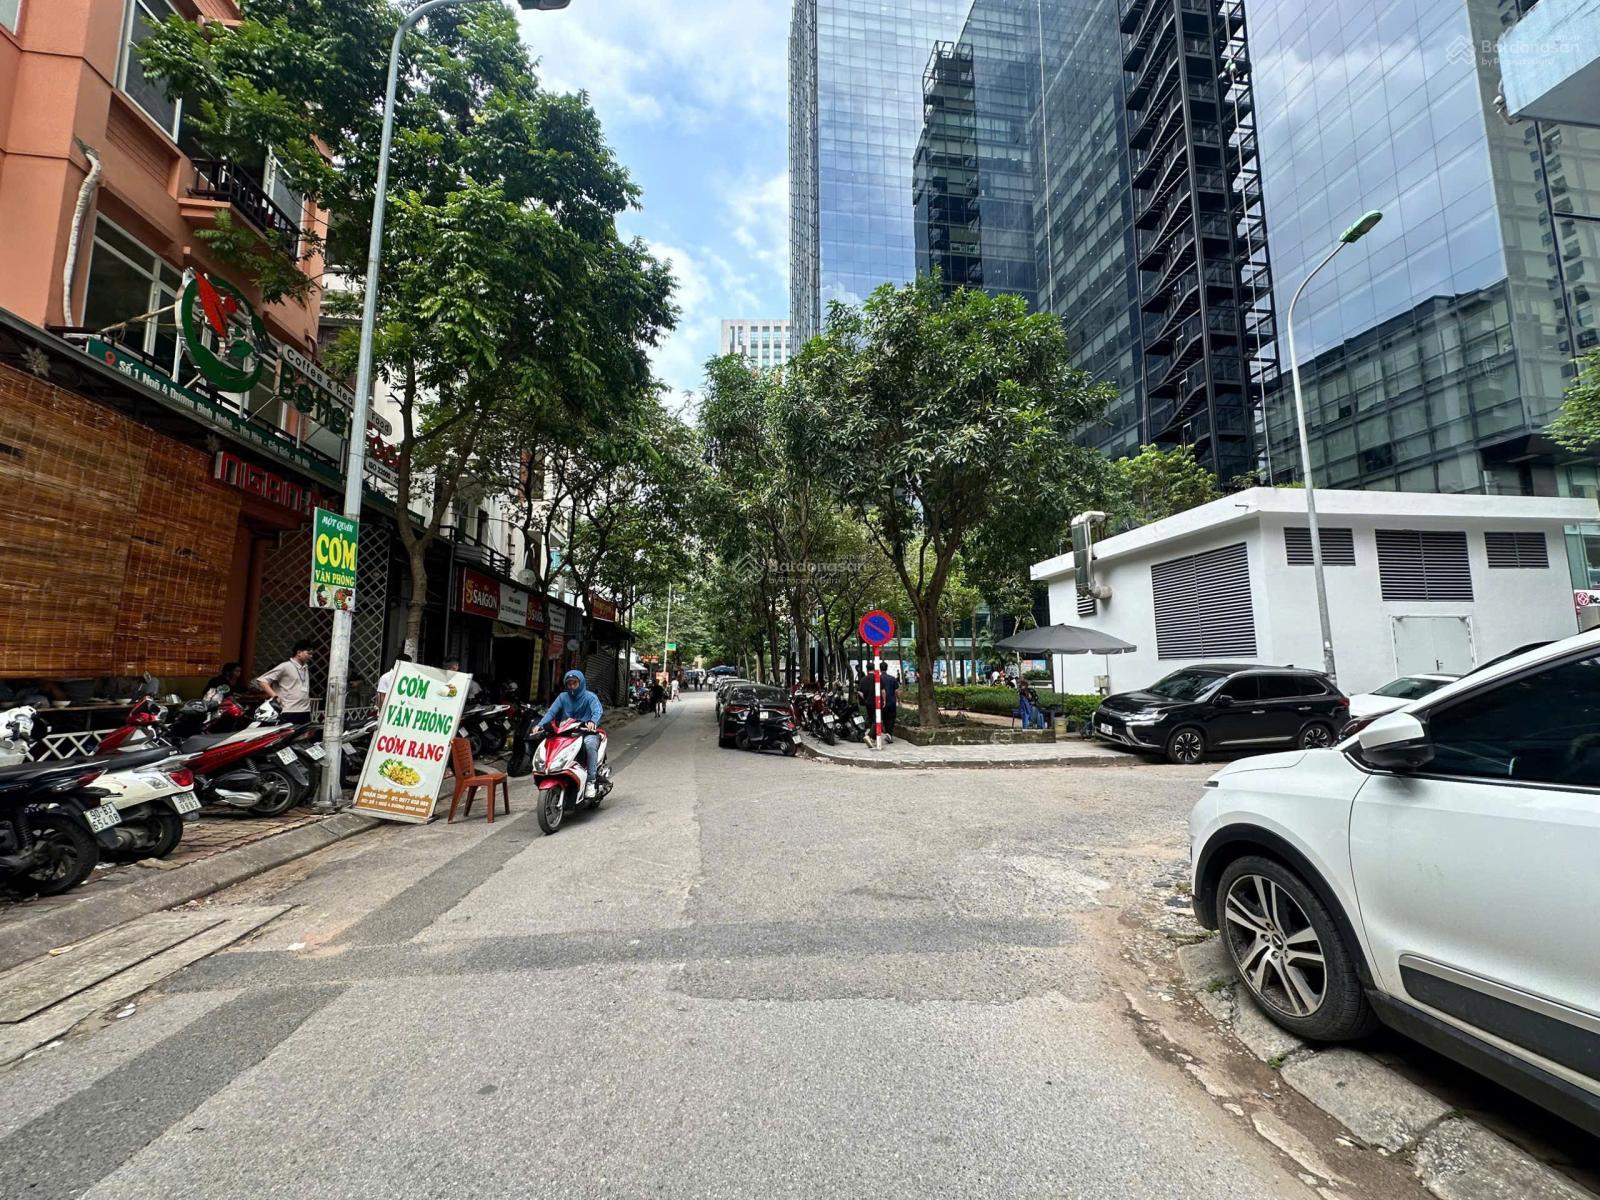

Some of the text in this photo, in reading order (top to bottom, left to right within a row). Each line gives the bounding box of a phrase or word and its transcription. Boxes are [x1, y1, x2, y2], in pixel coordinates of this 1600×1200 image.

[142, 372, 161, 391] Ngõ
[161, 383, 168, 395] 4
[286, 349, 323, 382] Coffee
[326, 381, 334, 391] &
[371, 413, 389, 432] Food
[316, 533, 356, 571] CƠM
[331, 572, 355, 587] PHÒNG
[472, 589, 497, 609] SAIGON
[397, 674, 430, 700] CƠM
[386, 701, 454, 735] VĂN PHÒNG
[376, 734, 407, 756] CƠM
[406, 741, 445, 762] RANG
